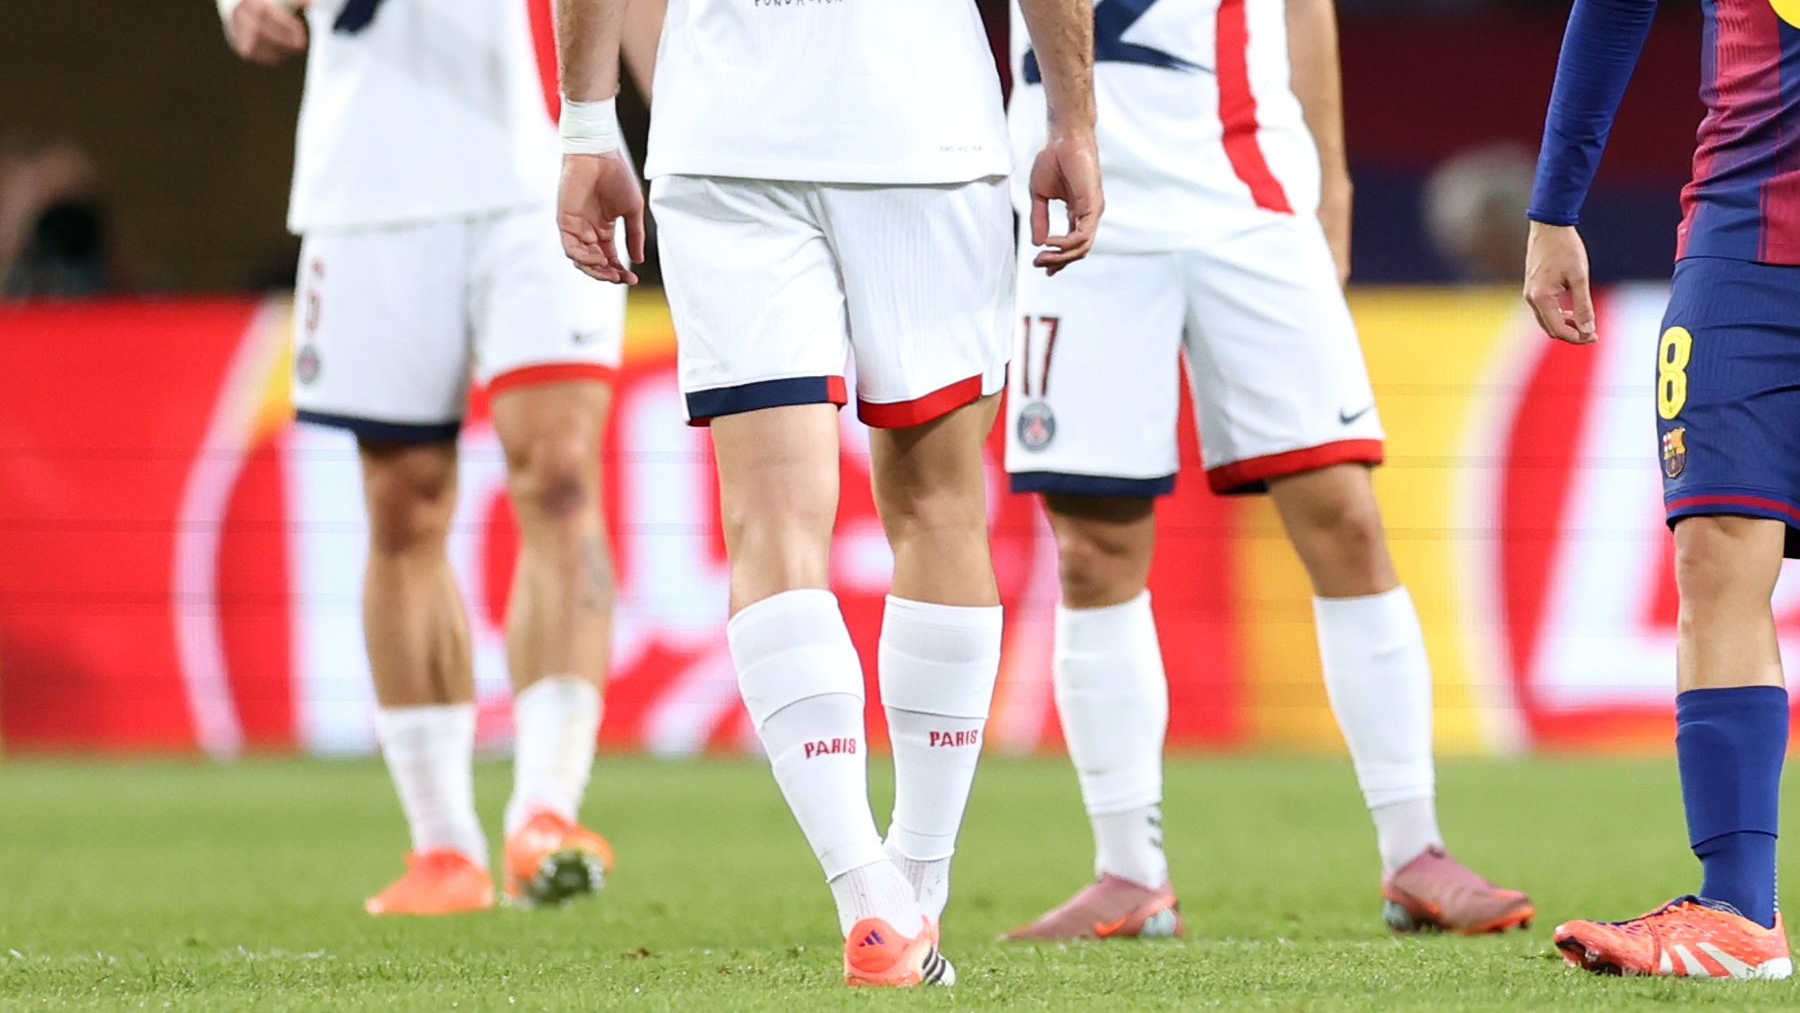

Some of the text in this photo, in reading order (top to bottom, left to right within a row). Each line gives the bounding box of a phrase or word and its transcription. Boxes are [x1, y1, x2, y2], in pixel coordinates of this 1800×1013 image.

[1022, 315, 1060, 397] 17
[1658, 326, 1693, 419] 8
[804, 738, 857, 759] PARIS
[929, 729, 979, 747] PARIS
